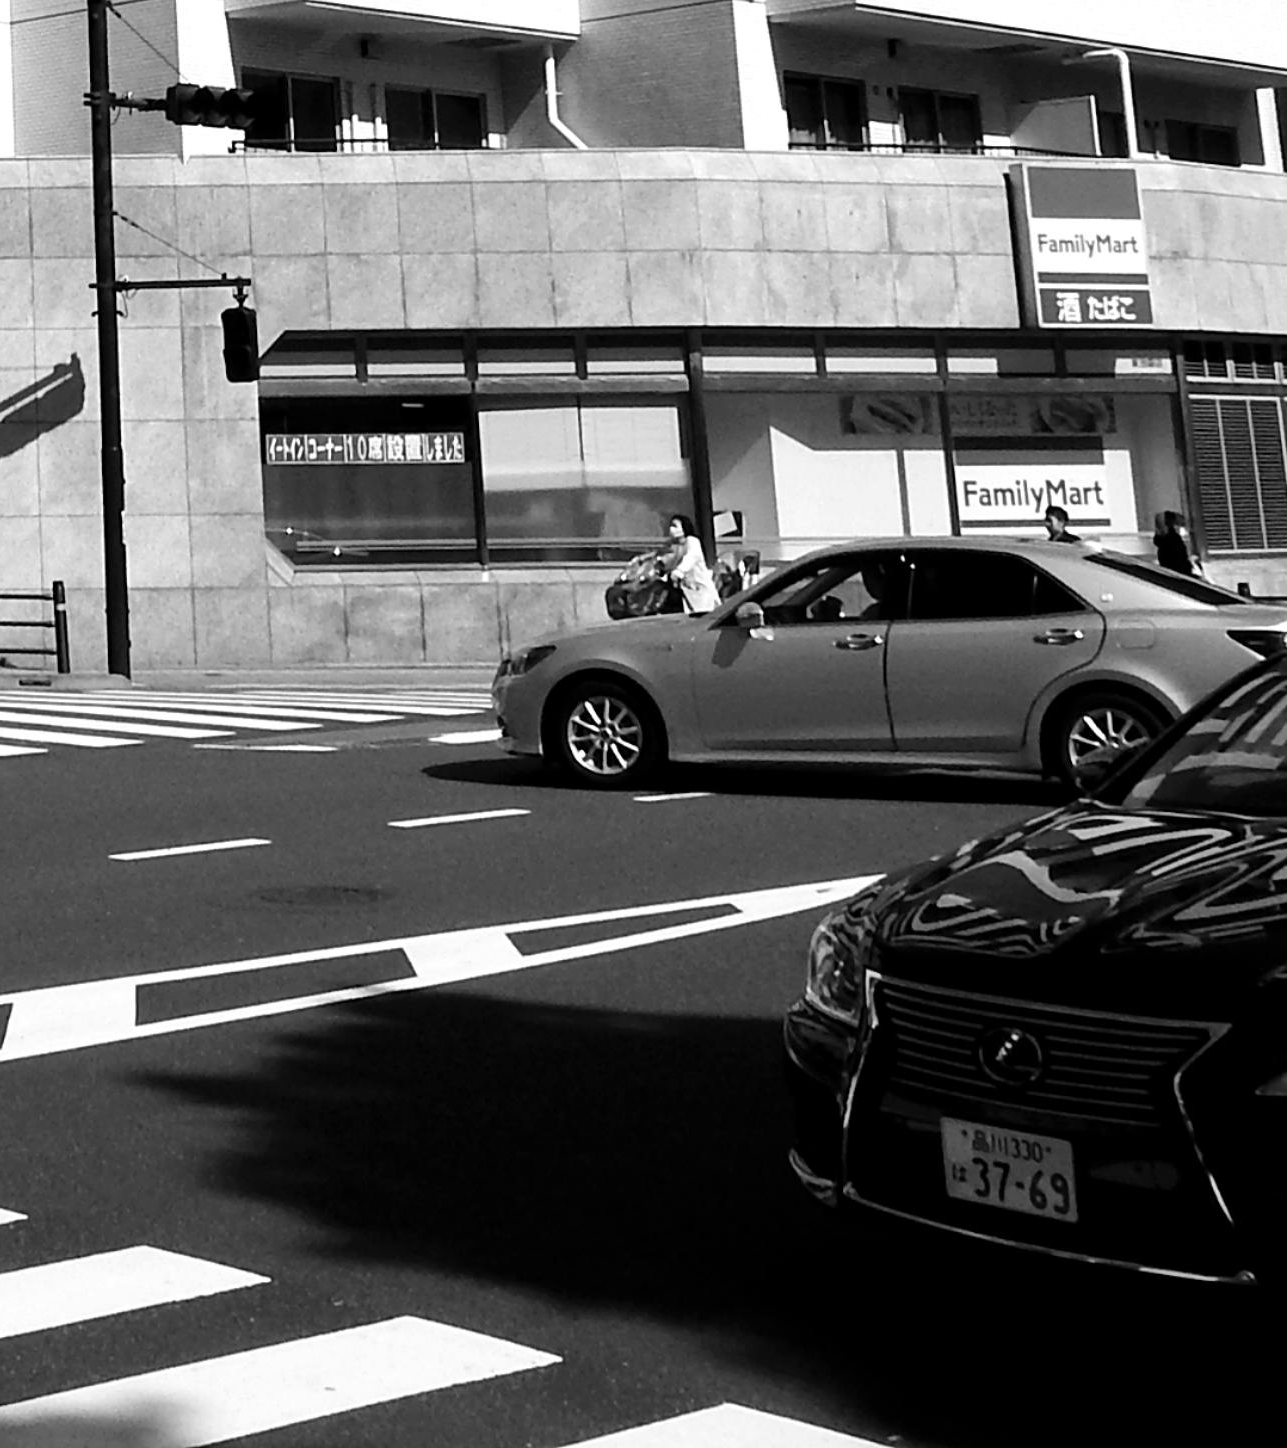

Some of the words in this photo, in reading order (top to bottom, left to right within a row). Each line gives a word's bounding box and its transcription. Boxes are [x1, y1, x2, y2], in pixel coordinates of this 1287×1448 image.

[1037, 233, 1139, 258] FamilyMart
[1086, 295, 1138, 321] たばこ
[963, 479, 1105, 513] FamilyMart
[972, 1156, 1071, 1215] 37-69
